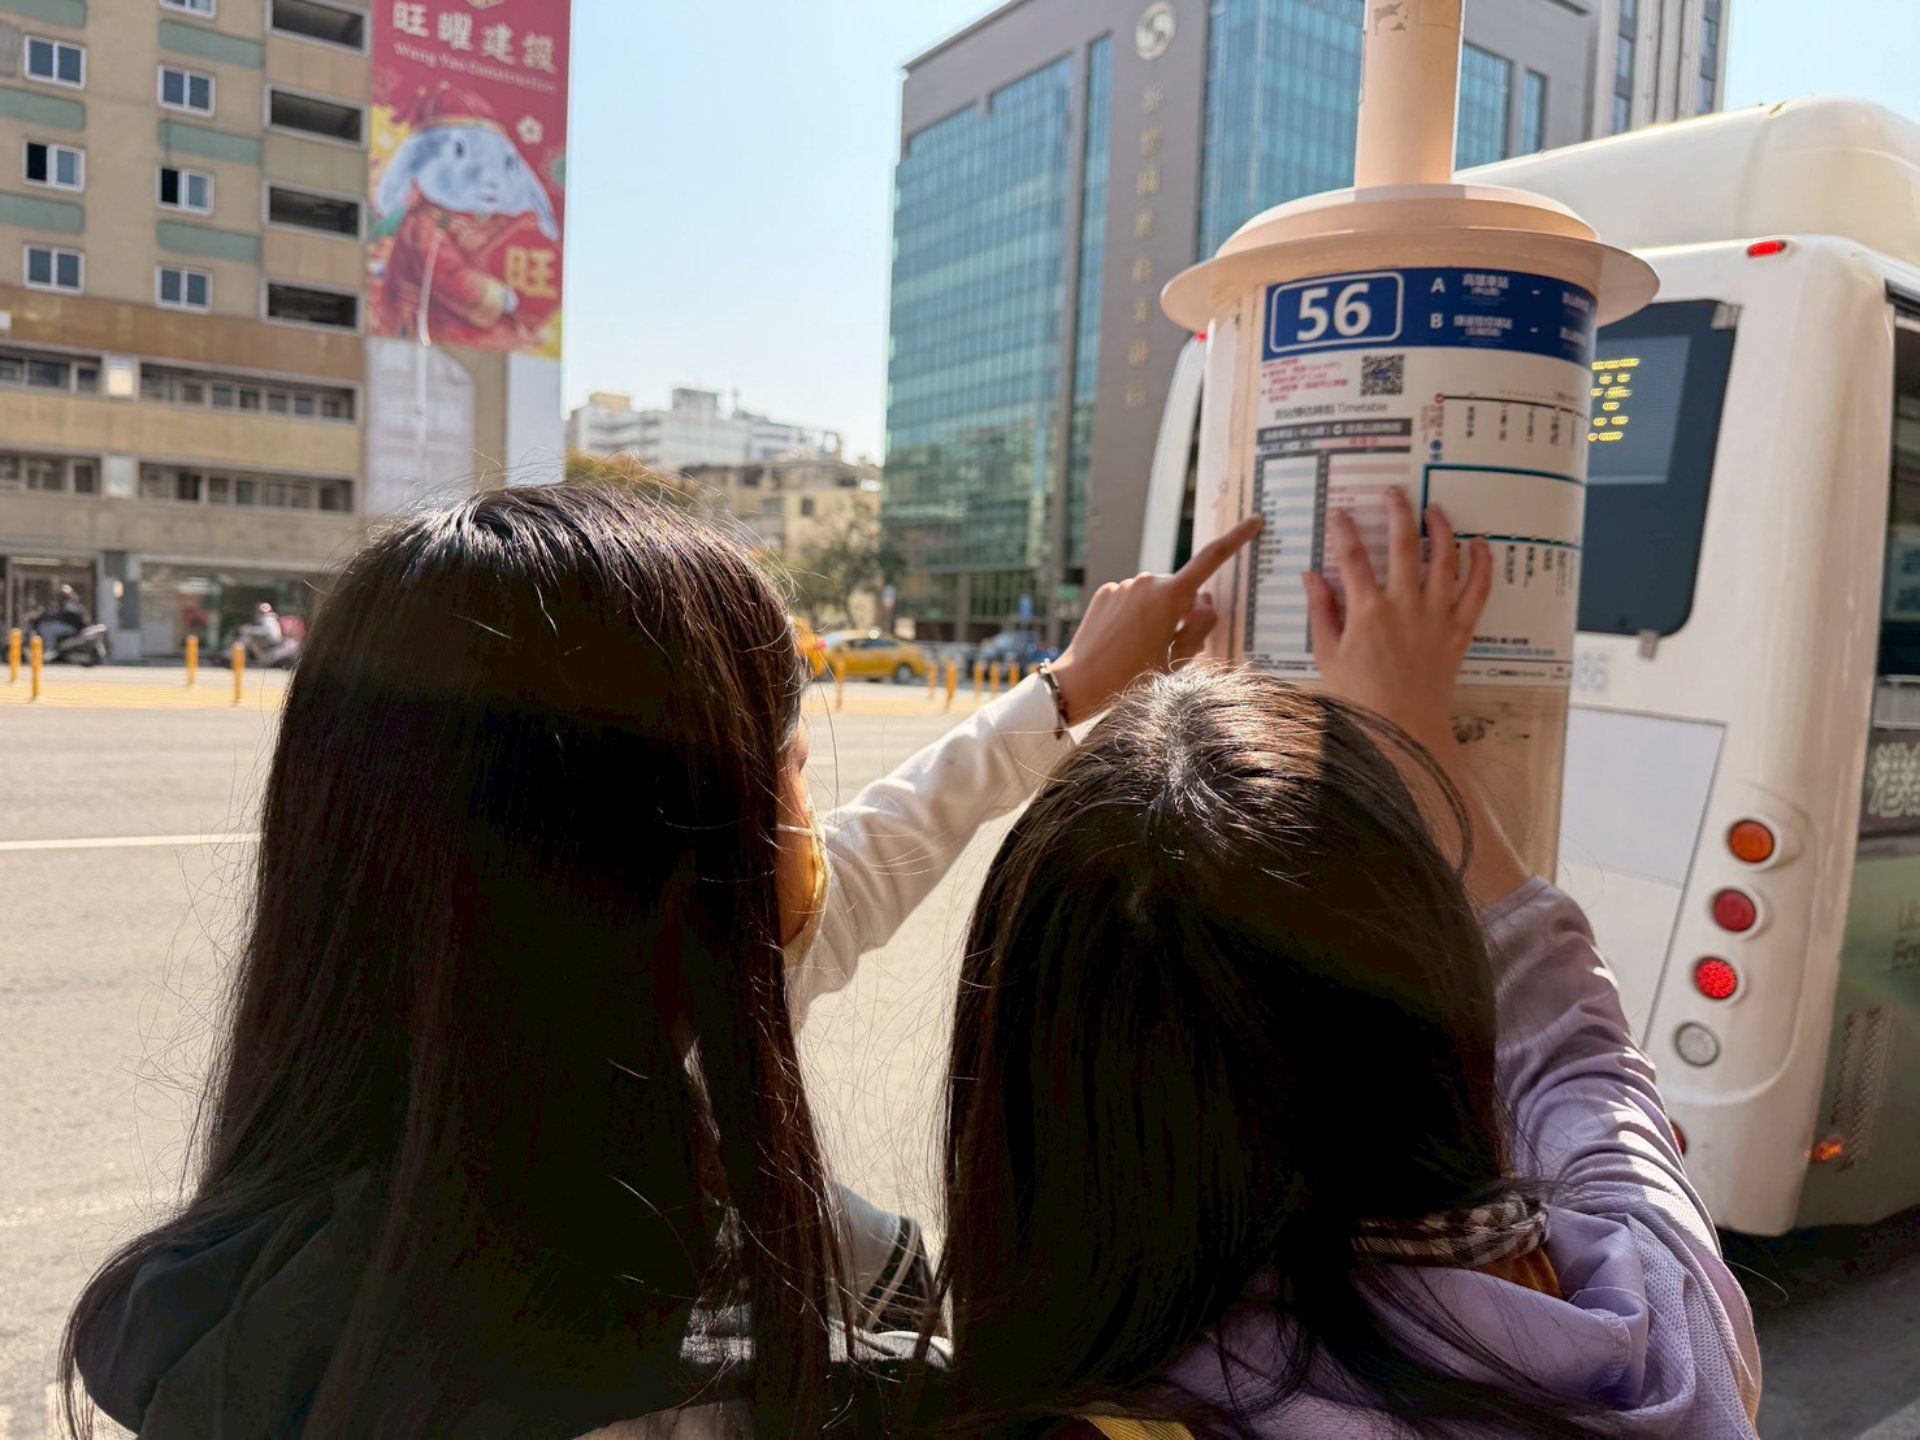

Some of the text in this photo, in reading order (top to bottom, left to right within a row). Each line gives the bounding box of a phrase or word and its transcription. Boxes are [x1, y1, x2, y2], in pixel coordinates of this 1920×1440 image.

[506, 247, 558, 298] 旺
[1430, 277, 1445, 293] A
[1296, 282, 1371, 342] 56
[1430, 313, 1444, 329] B
[1338, 401, 1388, 414] Timetable
